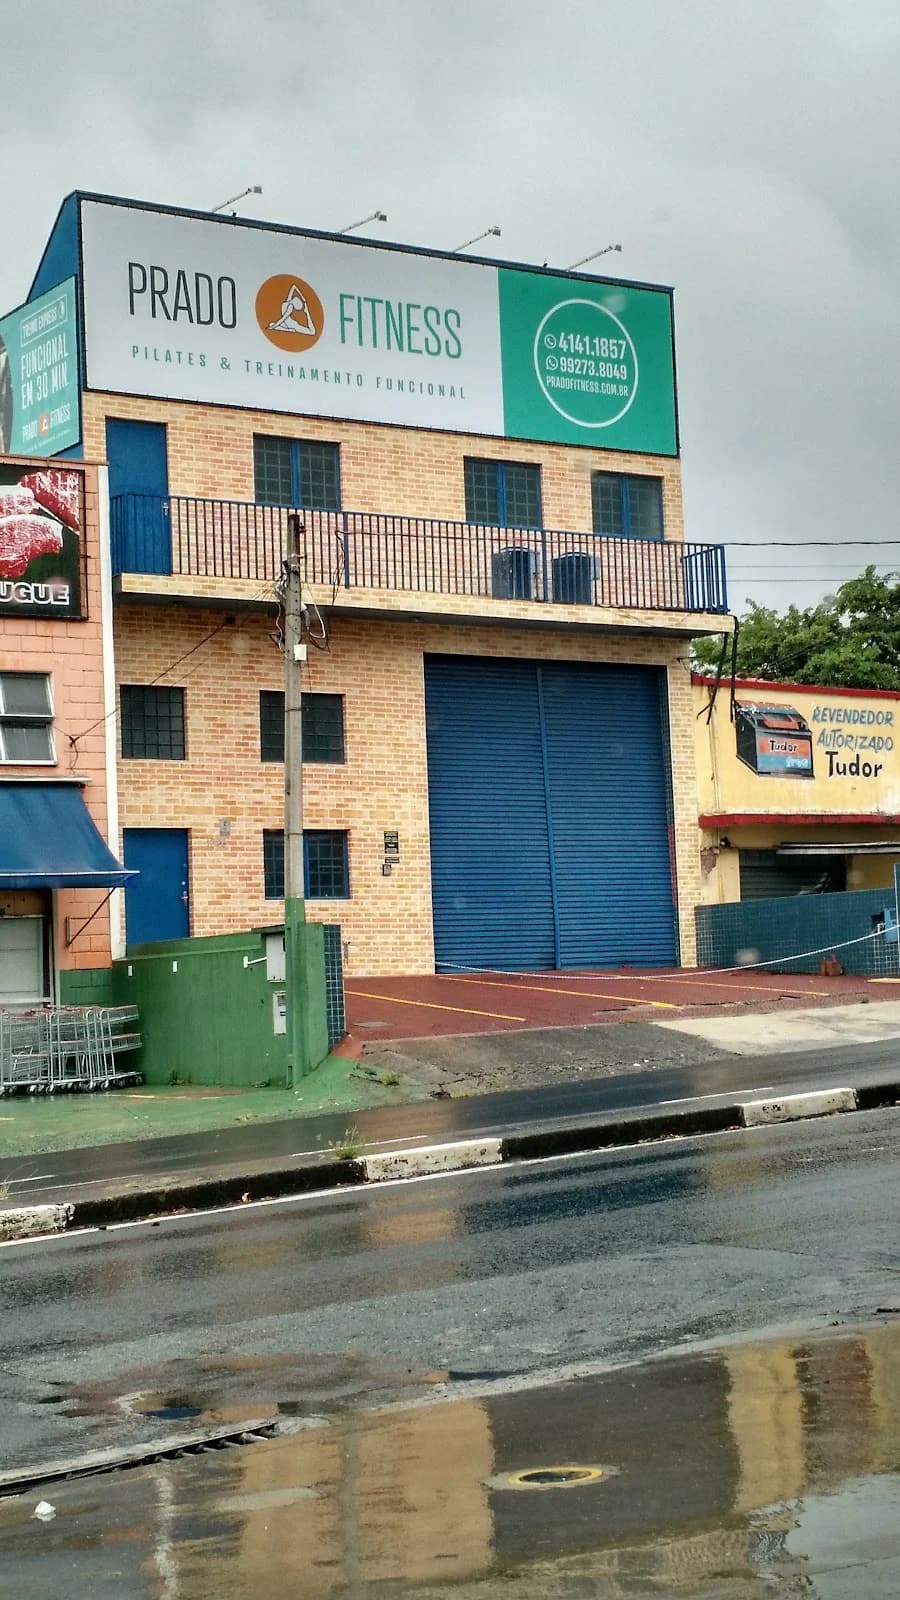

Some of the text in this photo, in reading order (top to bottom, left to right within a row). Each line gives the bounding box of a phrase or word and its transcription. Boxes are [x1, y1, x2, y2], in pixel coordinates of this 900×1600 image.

[128, 261, 462, 359] PRADO FITNESS
[21, 332, 69, 382] FUNCIONAL
[558, 331, 627, 360] 4141.1857
[132, 345, 465, 399] PILATES & TREINAMENTO FUNCIONAL
[560, 356, 628, 381] 99273.8049
[21, 381, 33, 409] EM
[36, 371, 49, 401] 30
[546, 375, 629, 397] PRADOFITNESS.COM.BR
[49, 403, 71, 429] FITNESS
[812, 706, 894, 727] REVENDEDOR
[769, 740, 798, 752] Tudor
[816, 728, 894, 753] AUTORIZADO
[825, 751, 883, 778] Tudor
